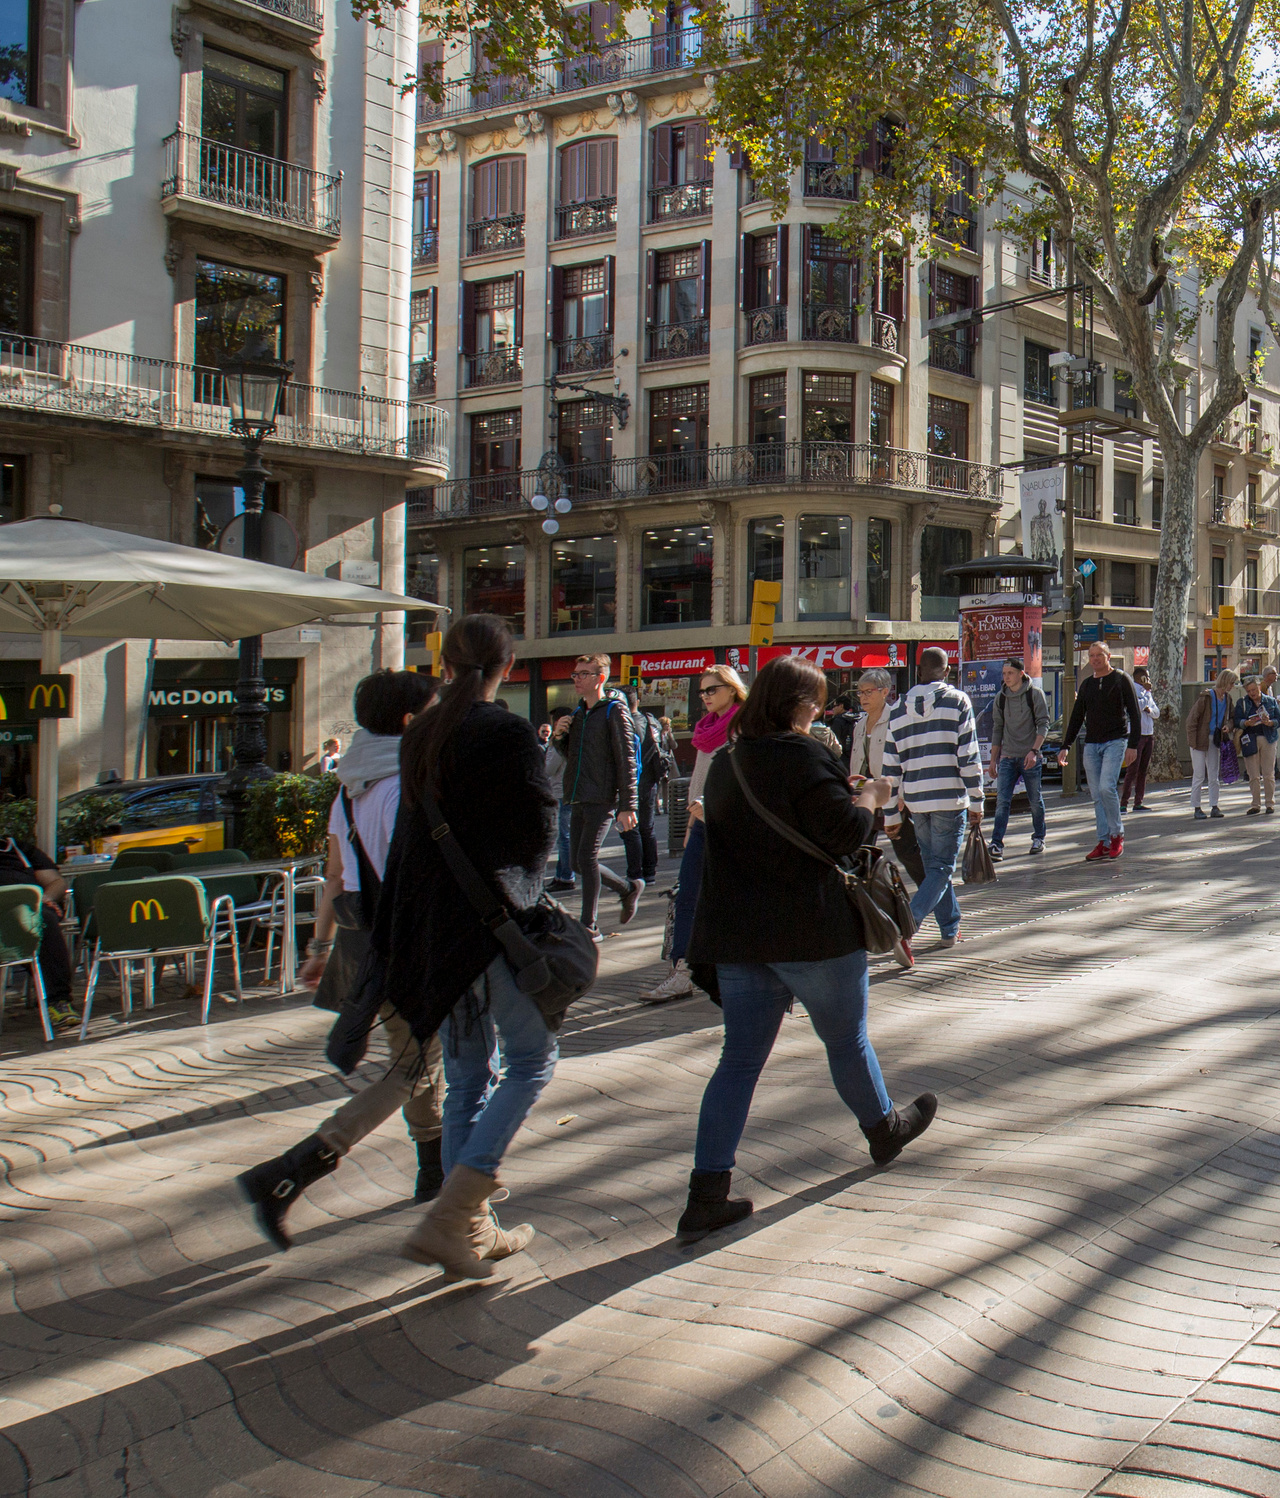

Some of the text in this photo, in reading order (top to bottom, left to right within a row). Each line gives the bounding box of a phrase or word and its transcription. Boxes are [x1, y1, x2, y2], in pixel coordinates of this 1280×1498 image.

[1022, 477, 1062, 491] NABUCCO
[1083, 564, 1093, 573] W
[978, 620, 1022, 632] FLAMENCO
[790, 646, 857, 668] KFC
[640, 656, 706, 672] Restaurant
[980, 683, 996, 692] EIBAR
